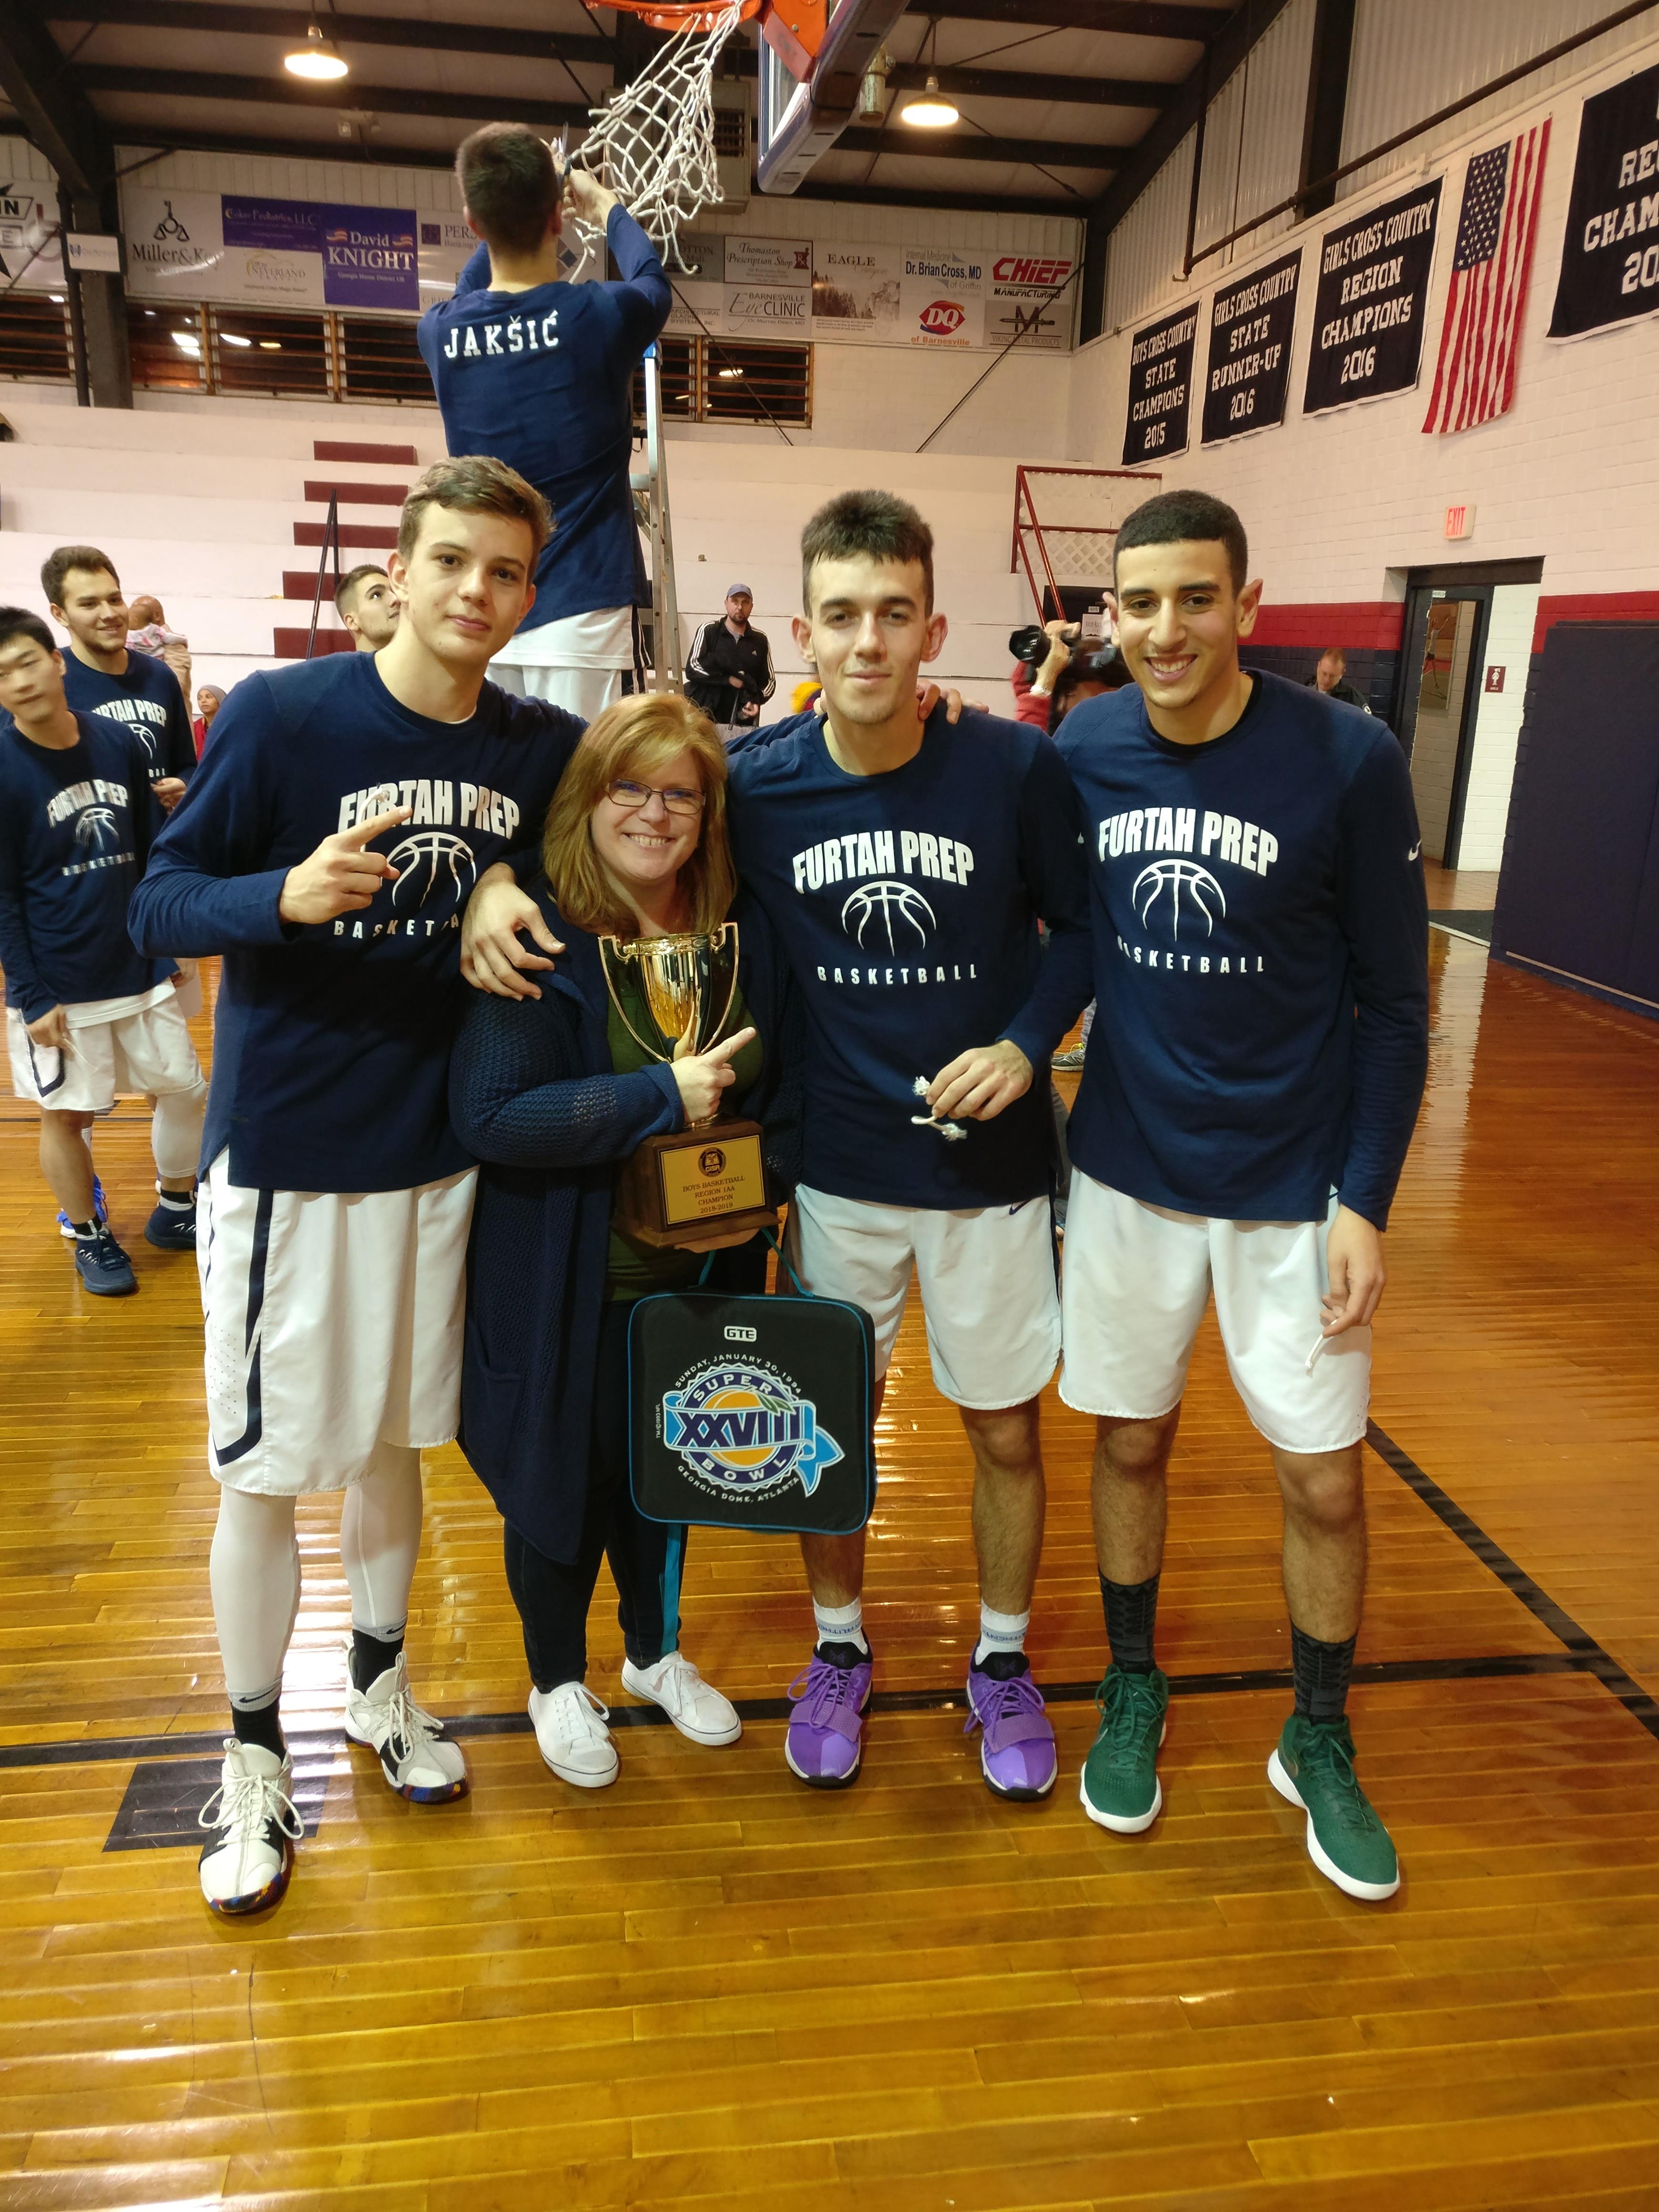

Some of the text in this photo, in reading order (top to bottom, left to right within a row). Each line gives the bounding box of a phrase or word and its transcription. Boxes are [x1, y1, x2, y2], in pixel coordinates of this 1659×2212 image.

[1618, 140, 1659, 189] RE
[349, 231, 389, 247] David
[445, 225, 477, 239] PER
[1323, 198, 1435, 274] GIRLS CROSS COUNTRY
[328, 246, 414, 270] KNIGHT
[727, 253, 793, 268] Prescription Shop
[739, 242, 780, 255] Thomaston
[828, 254, 875, 266] EAGLE
[906, 261, 981, 280] Dr. Brian Cross, MD
[1341, 256, 1403, 305] REGION
[1622, 246, 1659, 294] 20
[749, 293, 805, 301] BARNESVILLE
[764, 301, 805, 317] CLINIC
[1214, 264, 1297, 327] GIRLS CROSS COUNTRY
[927, 308, 959, 329] DQ
[1321, 294, 1414, 349] CHAMPIONS
[444, 309, 559, 358] JAKŠIĆ
[922, 336, 970, 346] Barnesville
[1032, 338, 1059, 346] PRODUCTS
[1132, 315, 1196, 366] BOYS CROSS COUNTRY
[1230, 315, 1270, 352] STATE
[1145, 358, 1176, 389] STATE
[1211, 344, 1281, 391] RUNNER-UP
[1341, 347, 1375, 383] 2016
[1133, 385, 1185, 421] CHAMPIONS
[1230, 389, 1255, 420] 2016
[1145, 422, 1165, 449] 2015
[1446, 507, 1466, 536] EXIT
[92, 699, 167, 727] RTAH PREP
[460, 782, 520, 840] PREP
[1098, 807, 1278, 877] FURTAH PREP
[793, 830, 974, 894] FURTAH PREP
[334, 913, 459, 938] BASKETA
[817, 964, 977, 985] BASKETBALL
[683, 1176, 745, 1192] BOYS BASKETBALL
[695, 1188, 721, 1198] REGION
[698, 1194, 733, 1206] CHAMPION
[700, 1202, 733, 1213] 2018-2019
[727, 1329, 755, 1339] GTE
[675, 1354, 801, 1394] SUNDAY, JANUARY 30, 1994
[693, 1374, 772, 1402] SUPER
[676, 1404, 801, 1447] XXVIII
[701, 1458, 787, 1481] BOWL
[678, 1465, 799, 1503] GEORGIA DOME, ATLANTA
